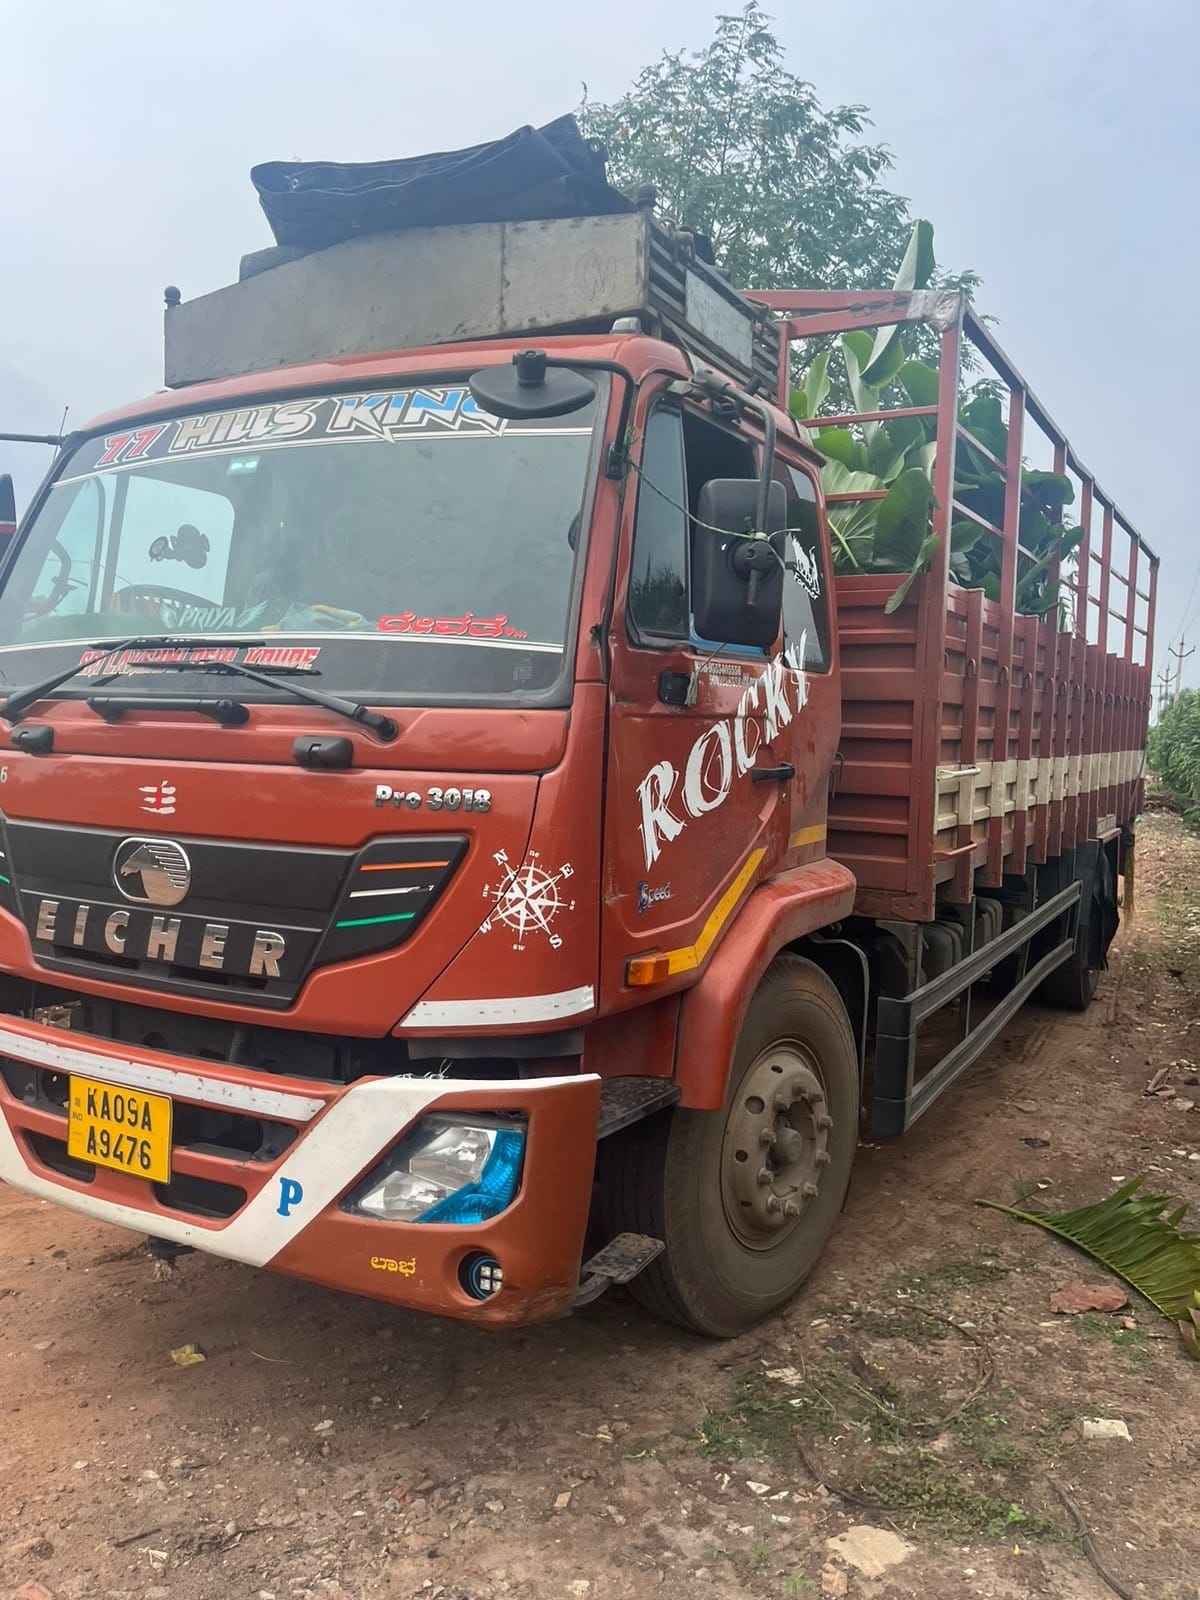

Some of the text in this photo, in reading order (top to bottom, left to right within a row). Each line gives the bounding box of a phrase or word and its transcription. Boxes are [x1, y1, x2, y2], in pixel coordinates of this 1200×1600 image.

[95, 423, 172, 468] 77
[168, 399, 330, 453] HILLS
[178, 607, 236, 631] PRIYA
[636, 629, 809, 872] ROCKY
[375, 784, 491, 812] Pro 3018
[492, 848, 509, 866] N
[559, 862, 575, 879] E
[36, 899, 286, 977] EICHER
[479, 917, 492, 934] W
[549, 933, 563, 949] S
[87, 1125, 151, 1170] A9476
[276, 1176, 304, 1217] P
